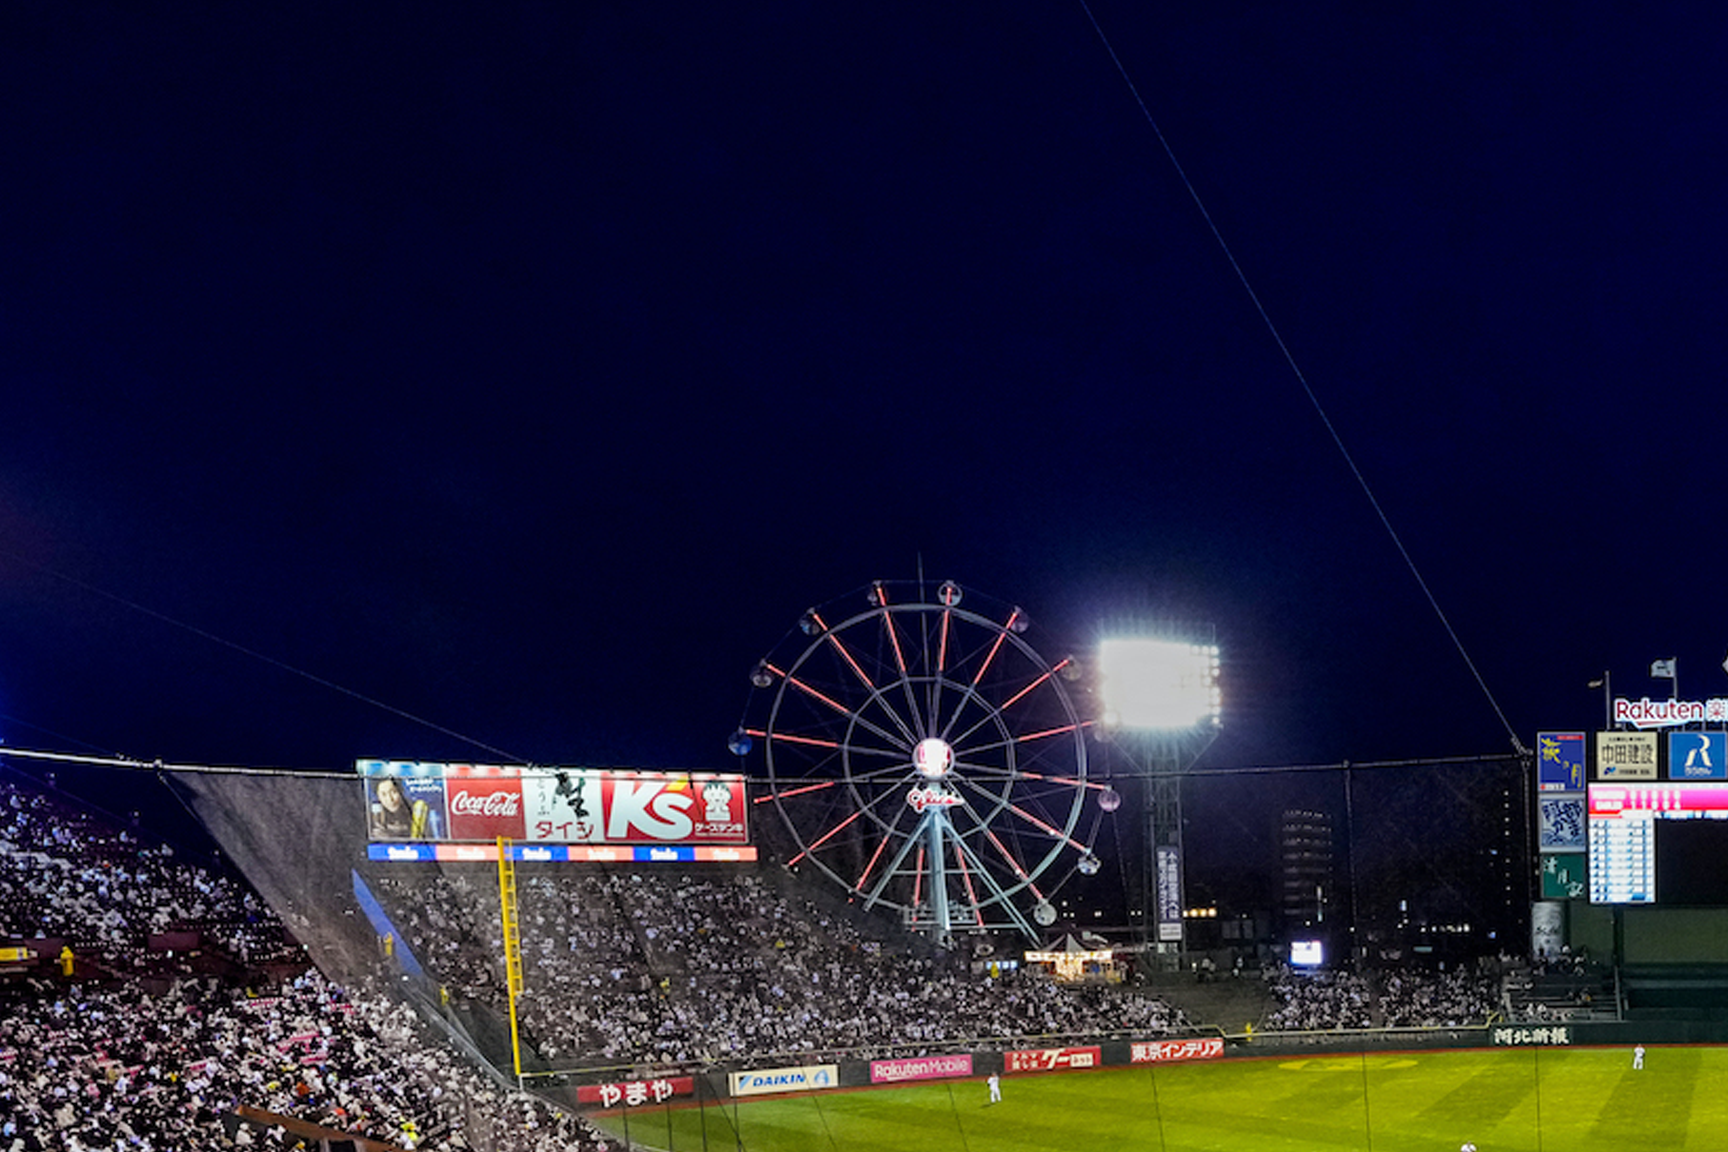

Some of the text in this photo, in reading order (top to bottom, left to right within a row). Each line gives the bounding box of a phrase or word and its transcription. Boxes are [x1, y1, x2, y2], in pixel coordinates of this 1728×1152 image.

[1616, 701, 1703, 719] Rakuten
[1602, 744, 1654, 765] 中田建設
[451, 790, 520, 816] Coca-Cola
[1131, 1041, 1222, 1062] 東京インテリア
[873, 1058, 970, 1081] Rakuten Mobile
[752, 1073, 806, 1088] DAIKIN
[600, 1079, 673, 1108] やまや
